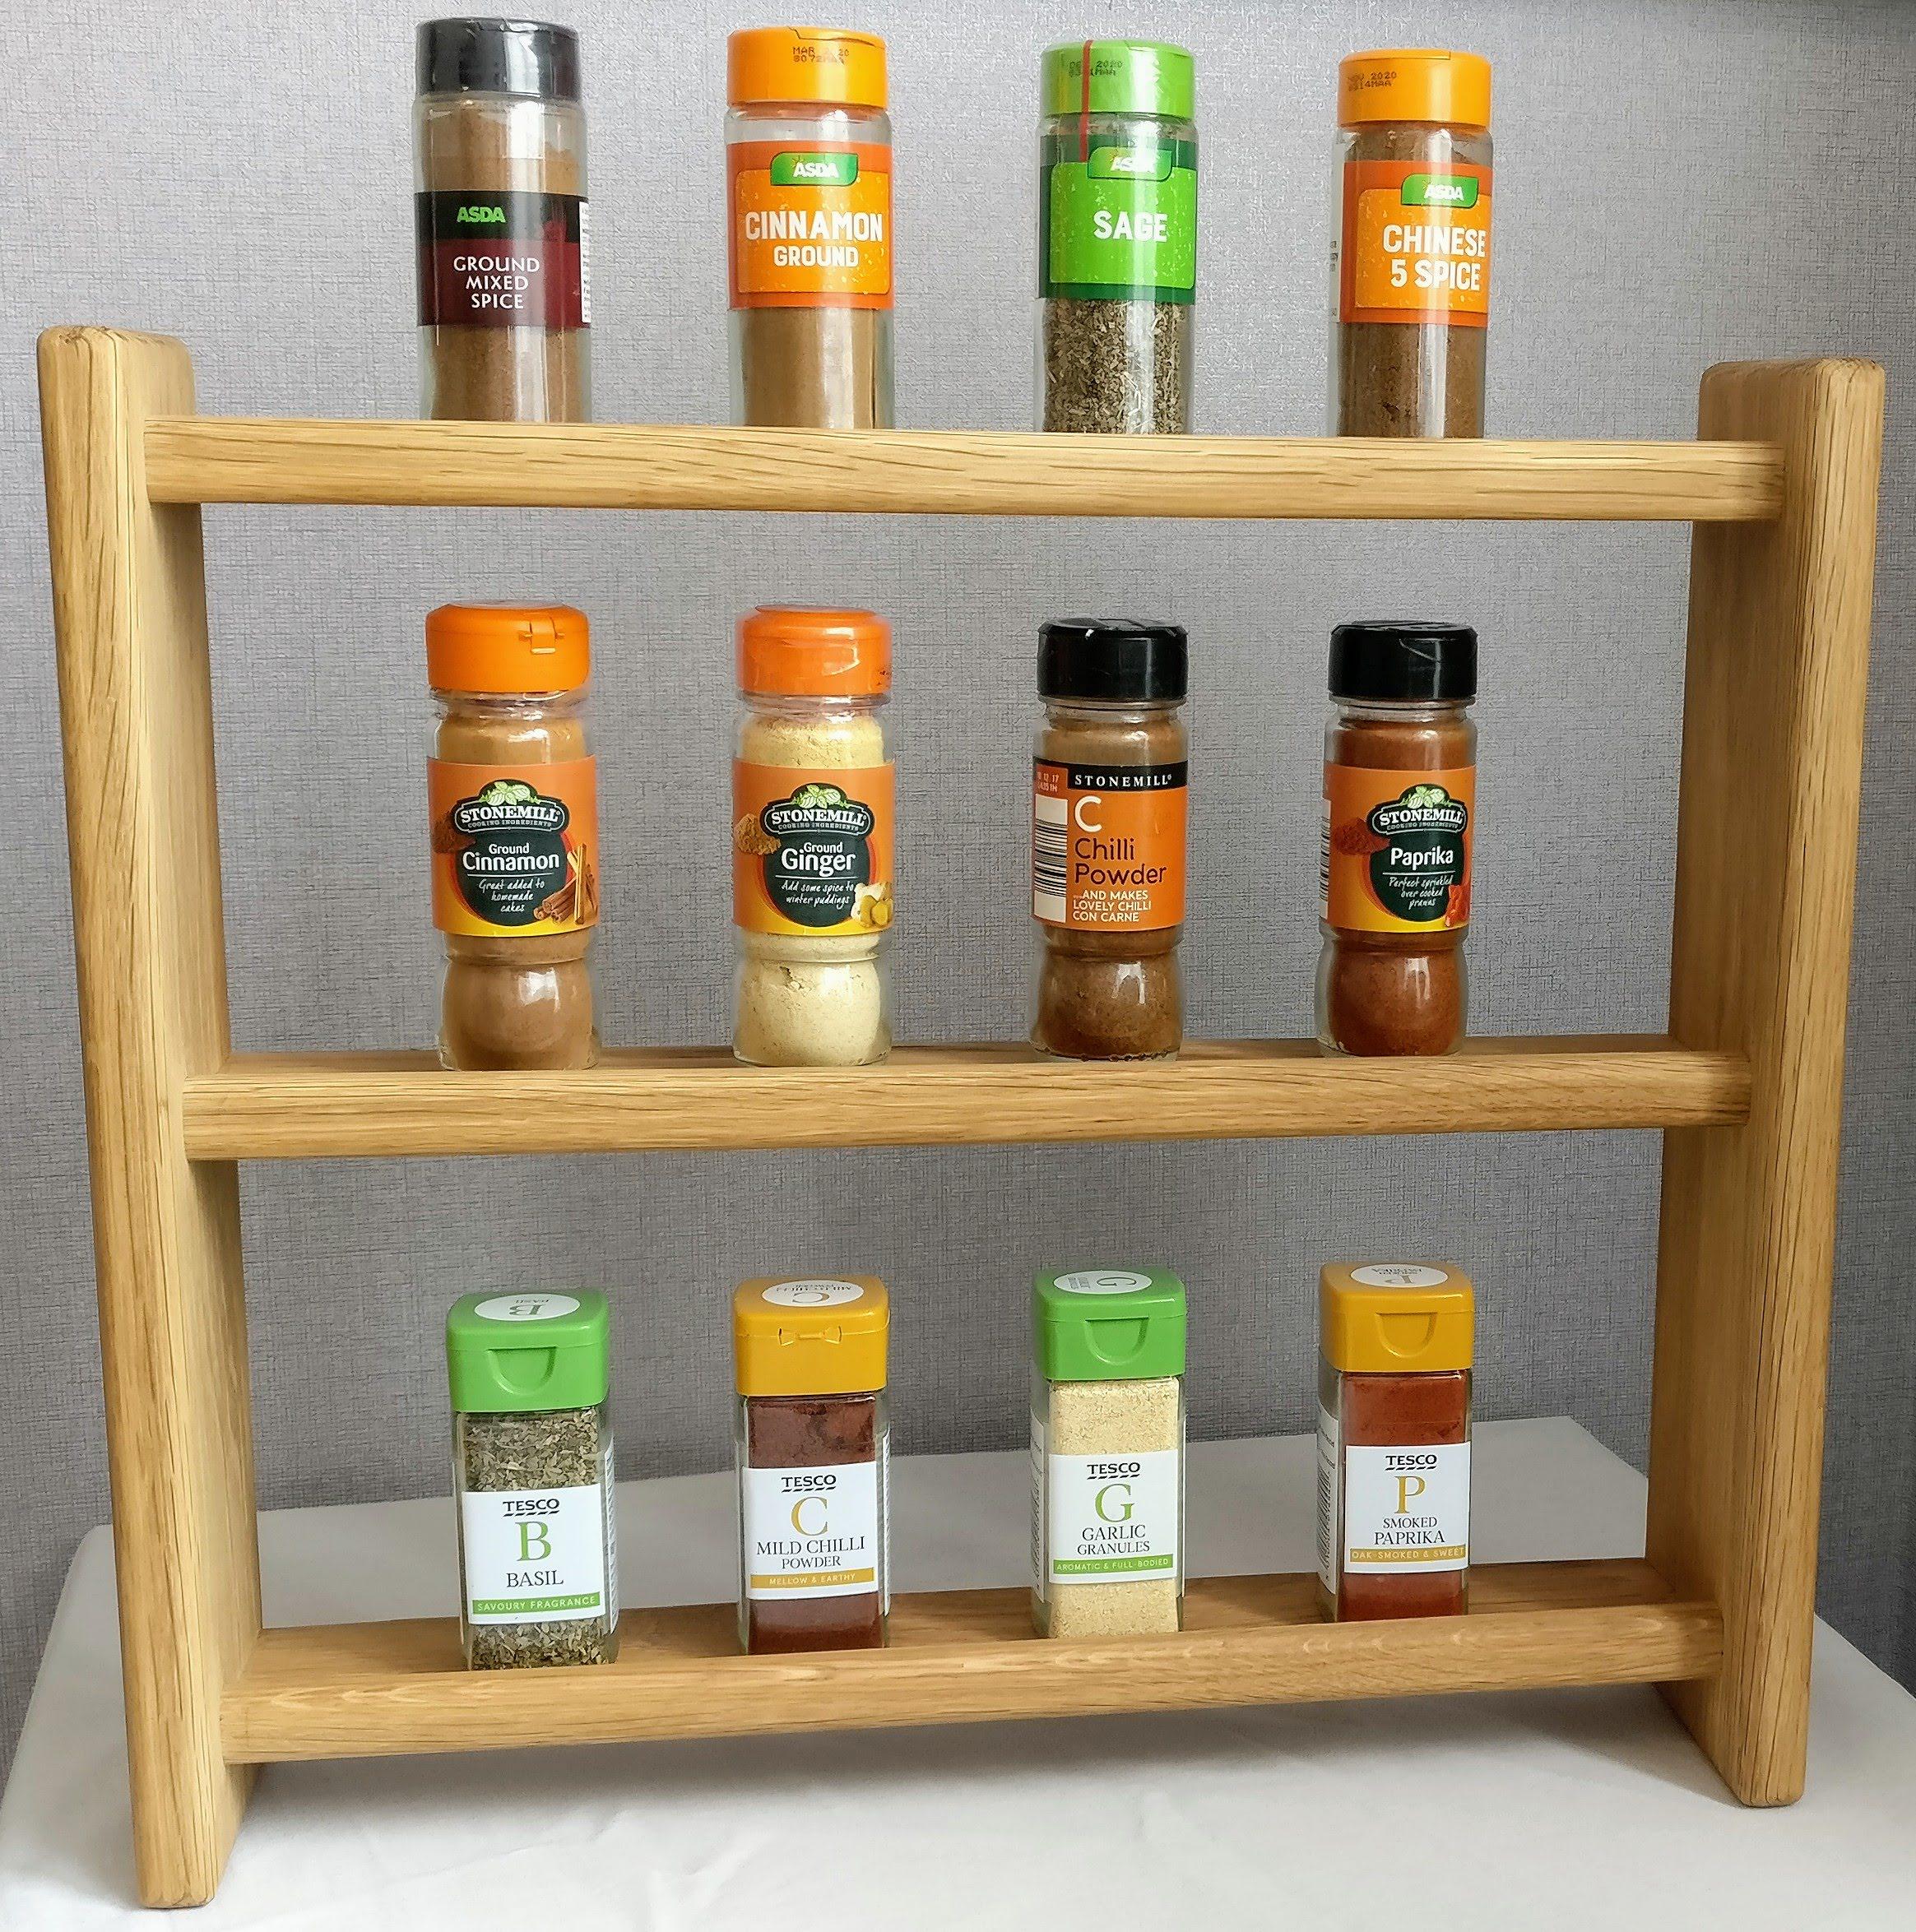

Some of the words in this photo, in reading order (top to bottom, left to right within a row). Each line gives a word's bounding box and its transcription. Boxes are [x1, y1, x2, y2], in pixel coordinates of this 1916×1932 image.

[792, 46, 815, 55] MAR
[1370, 72, 1397, 80] 2020
[792, 159, 839, 178] ASDA
[1424, 183, 1464, 202] ASDA
[457, 206, 506, 224] ASDA
[745, 210, 884, 242] CINNAMON
[1093, 211, 1167, 243] SAGE
[1382, 224, 1487, 258] CHINESE
[453, 256, 540, 273] GROUND
[773, 246, 860, 267] GROUND
[1390, 258, 1408, 288] 5
[1414, 259, 1482, 291] SPICE
[466, 275, 529, 291] MIXED
[471, 293, 524, 310] SPICE
[1074, 774, 1168, 788] STONEMILL
[460, 805, 559, 823] STONEMILL
[772, 808, 865, 827] STONEMILL
[1074, 795, 1102, 832] C
[1380, 808, 1463, 827] STONEMILL
[489, 843, 530, 855] Ground
[803, 841, 843, 854] Ground
[1074, 838, 1134, 860] Chilli
[462, 851, 559, 871] Cinnamon
[781, 848, 856, 878] Ginger
[1390, 846, 1454, 871] Paprika
[1074, 864, 1167, 885] Powder
[1389, 876, 1419, 889] Perfect
[1421, 875, 1454, 888] sprinkled
[479, 878, 504, 891] Great
[507, 878, 532, 890] added
[535, 878, 545, 889] to
[782, 879, 798, 892] Add
[800, 883, 821, 892] some
[823, 881, 843, 896] spice
[845, 880, 854, 892] to
[1400, 890, 1419, 898] over
[1420, 886, 1444, 897] cooked
[491, 890, 534, 902] homemade
[786, 892, 813, 905] winter
[814, 892, 850, 910] puddings
[1110, 890, 1148, 900] MAKES
[500, 902, 525, 912] cakes
[1073, 900, 1114, 911] LOVELY
[1118, 901, 1152, 911] CHILLI
[1408, 899, 1436, 910] prawns
[1073, 910, 1097, 921] CON
[1101, 912, 1139, 923] CARNE
[791, 1291, 830, 1304] C
[1385, 1454, 1437, 1466] TESCO
[1087, 1462, 1140, 1475] TESCO
[782, 1474, 837, 1488] TESCO
[1095, 1484, 1134, 1522] G
[1394, 1476, 1426, 1514] P
[503, 1498, 559, 1512] TESCO
[791, 1496, 828, 1536] C
[1383, 1517, 1438, 1529] SMOKED
[1082, 1524, 1146, 1541] GARLIC
[1375, 1530, 1445, 1545] PAPRIKA
[515, 1521, 552, 1562] B
[756, 1541, 801, 1555] MILD
[806, 1536, 865, 1553] CHILLI
[1077, 1541, 1150, 1555] GRANULES
[1434, 1546, 1465, 1558] SWEET
[782, 1555, 841, 1569] POWDER
[1056, 1562, 1101, 1572] AROMATIC
[1103, 1562, 1109, 1570] &
[506, 1570, 564, 1588] BASIL
[769, 1577, 808, 1586] MELLOW
[821, 1573, 856, 1582] EARTHY
[478, 1601, 525, 1612] SAVOURY
[530, 1596, 596, 1610] FRAGRANCE
